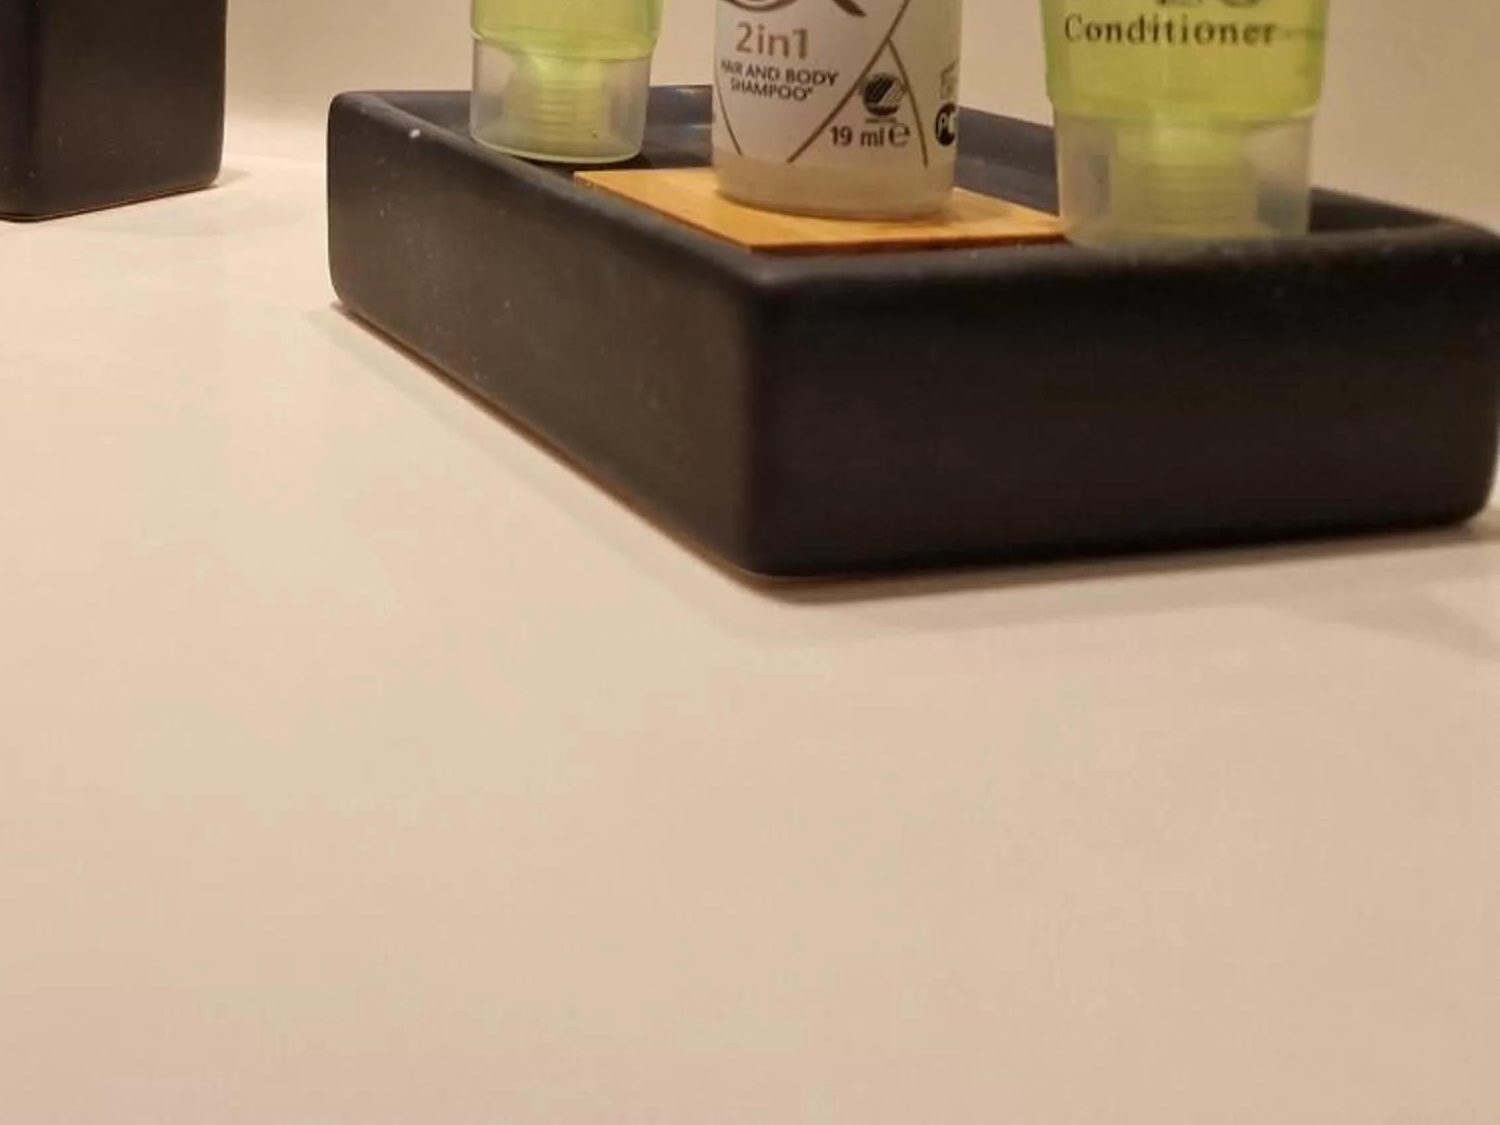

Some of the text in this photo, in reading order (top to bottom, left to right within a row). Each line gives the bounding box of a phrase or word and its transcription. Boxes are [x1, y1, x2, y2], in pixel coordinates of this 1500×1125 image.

[735, 20, 809, 59] 2in1
[1064, 12, 1278, 46] Conditioner
[746, 63, 780, 80] AND
[785, 67, 840, 87] BODY
[829, 125, 853, 147] 19
